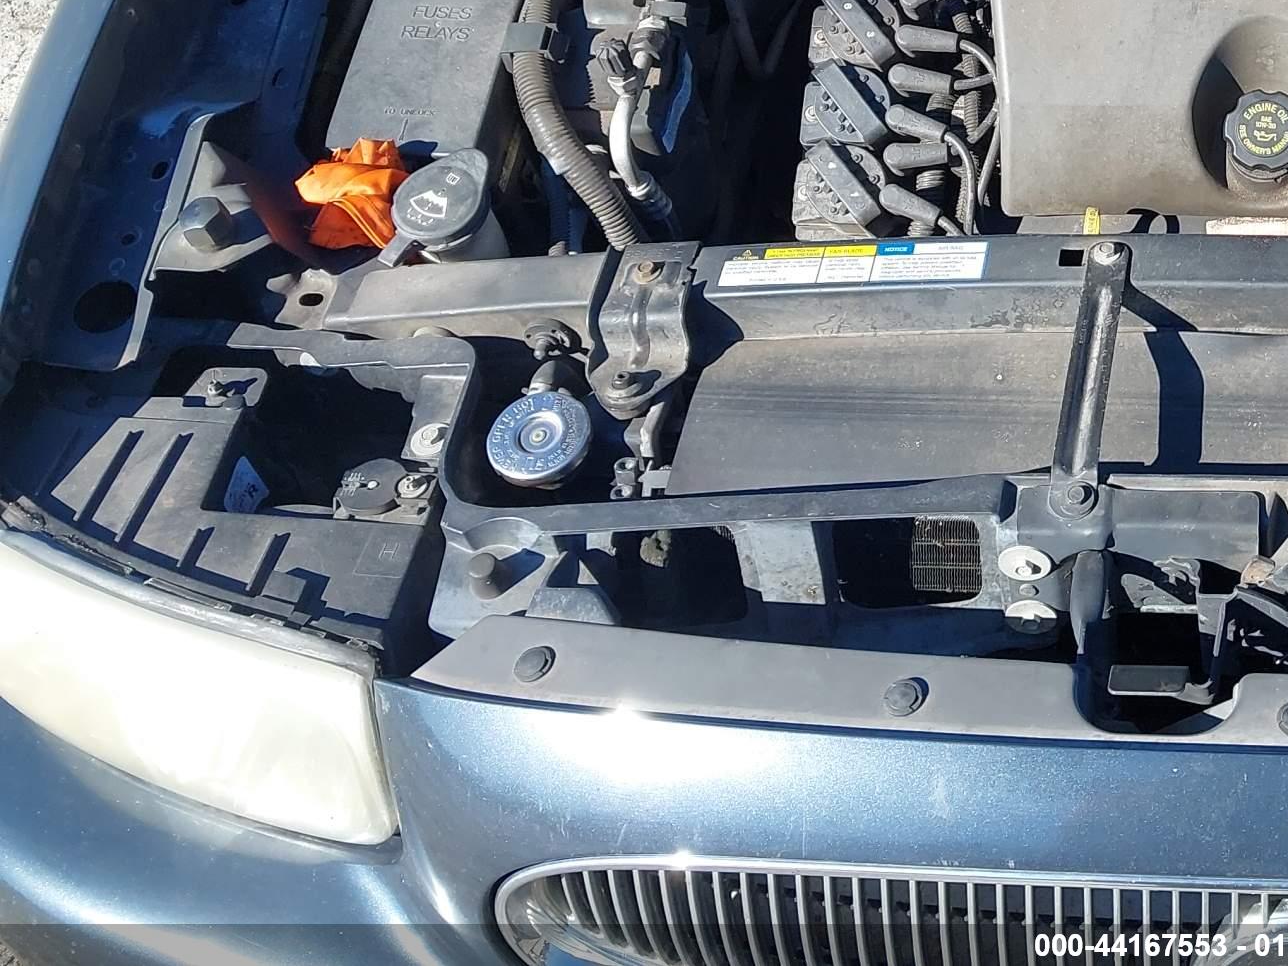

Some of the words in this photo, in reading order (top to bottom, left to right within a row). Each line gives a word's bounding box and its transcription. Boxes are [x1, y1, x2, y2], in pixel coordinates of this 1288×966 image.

[412, 4, 473, 21] FUSES
[400, 24, 472, 41] RELAYS
[1243, 102, 1278, 120] ENGINE
[1277, 109, 1288, 124] OIL
[1260, 115, 1274, 123] SAE
[1239, 124, 1248, 139] SEE
[1255, 121, 1278, 130] 10W-30
